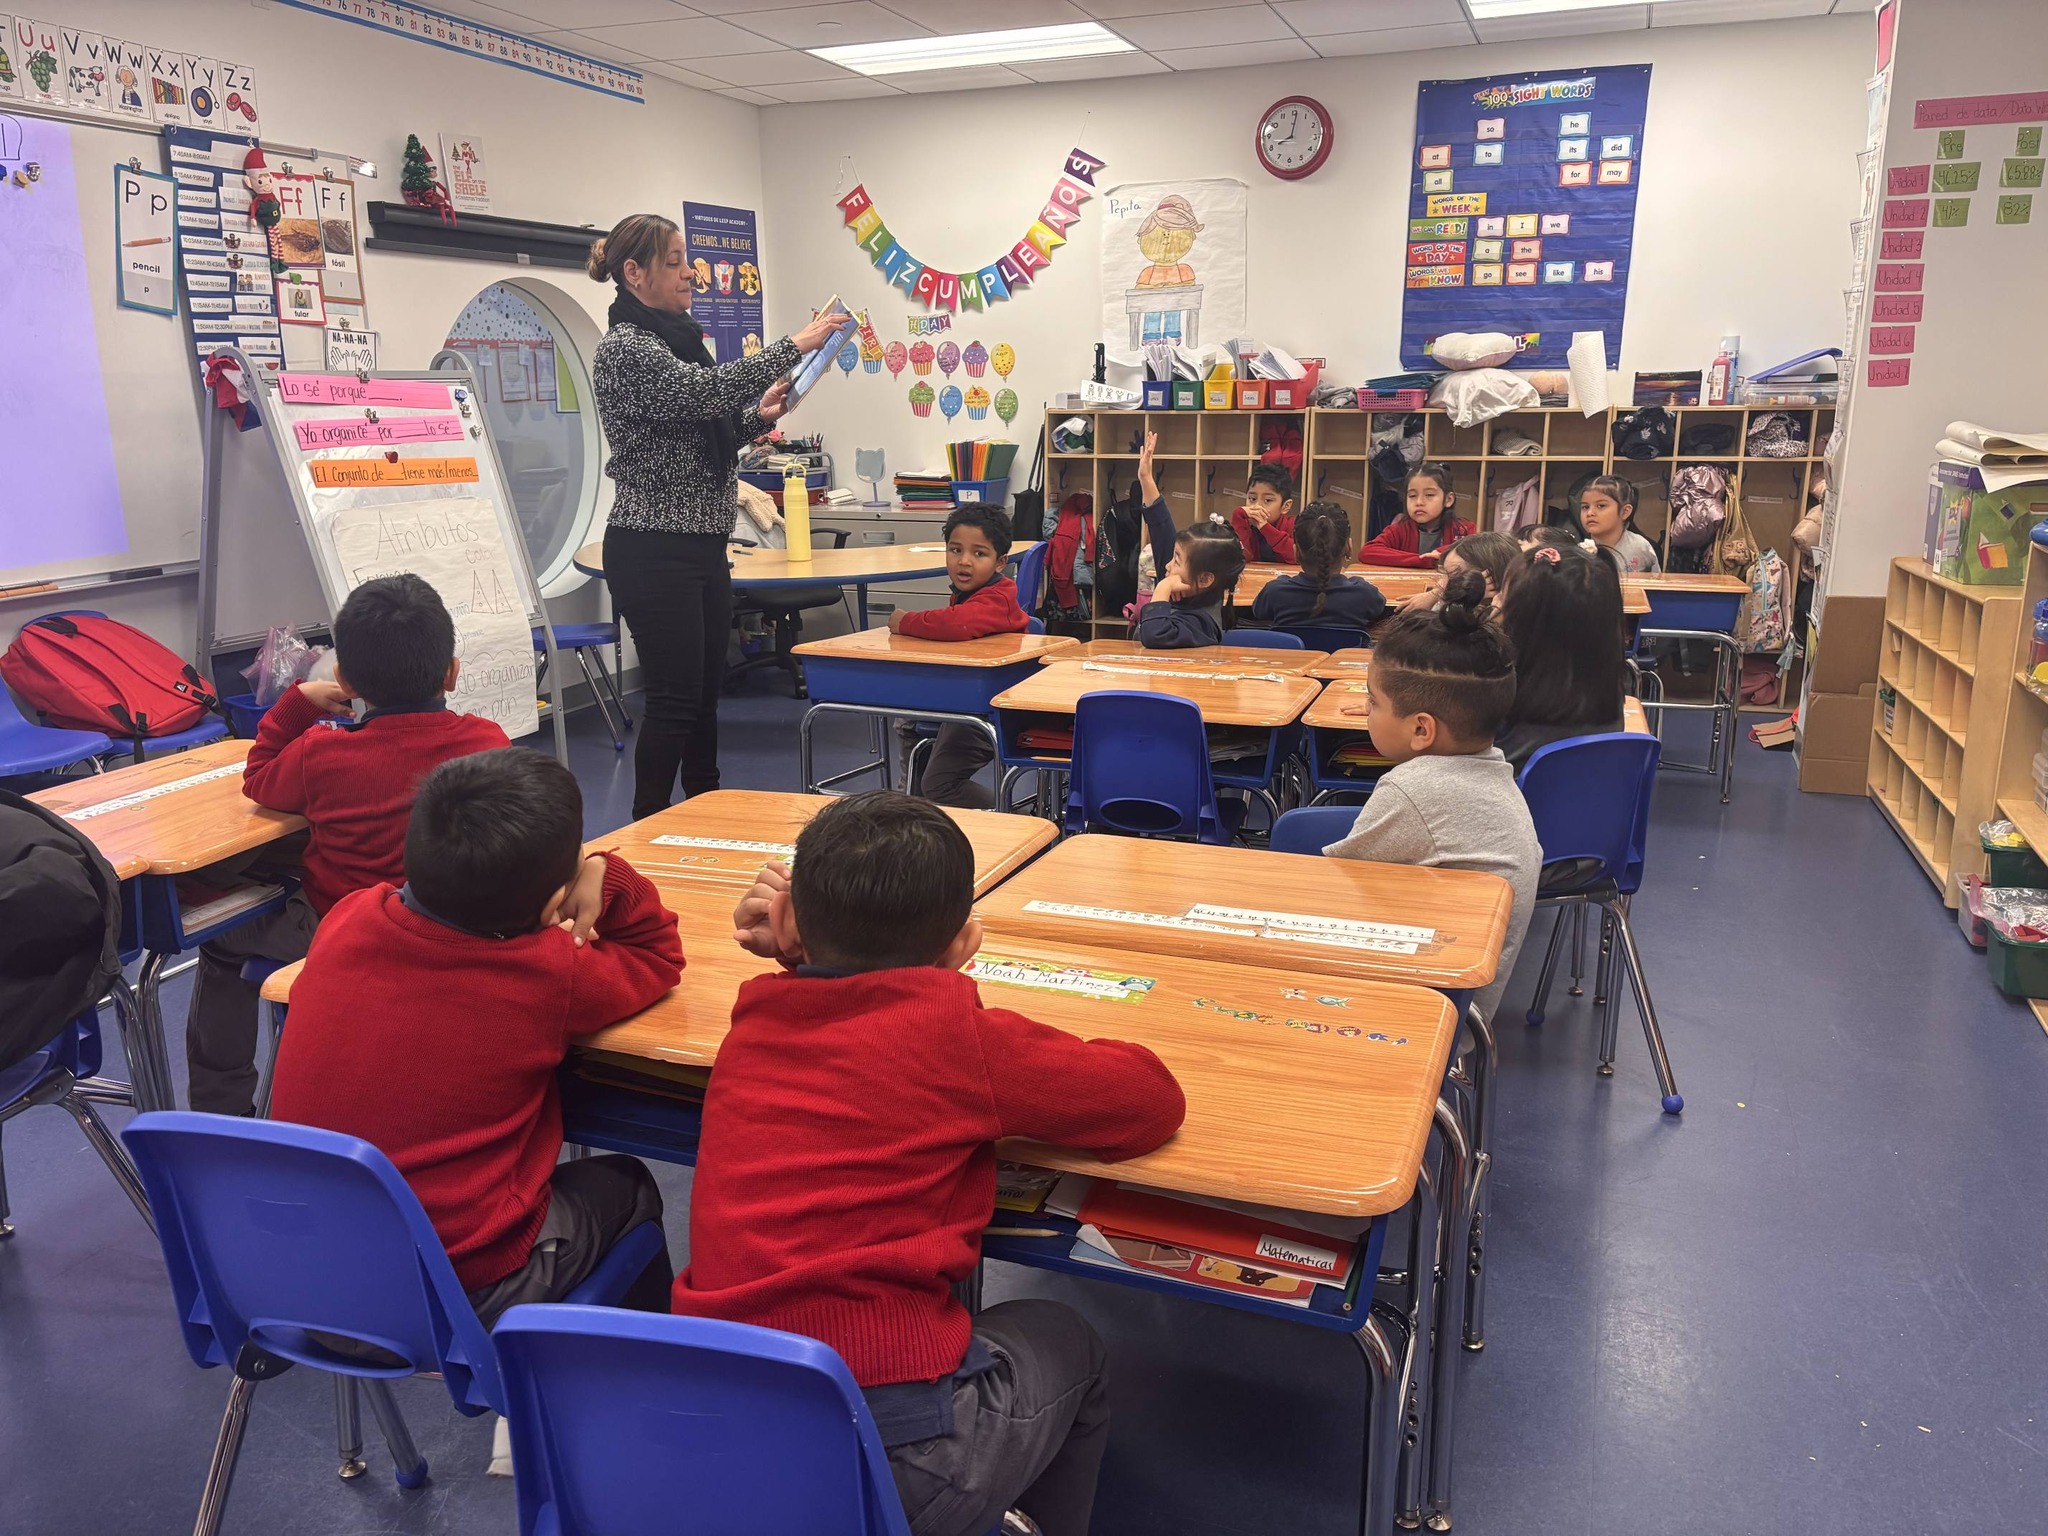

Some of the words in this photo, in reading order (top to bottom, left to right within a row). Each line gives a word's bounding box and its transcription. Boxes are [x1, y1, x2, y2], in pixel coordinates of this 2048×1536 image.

[353, 3, 361, 14] 77
[366, 7, 376, 18] 78
[380, 11, 390, 22] 79
[395, 16, 404, 26] 80
[410, 20, 417, 30] 81
[423, 24, 432, 34] 82
[437, 28, 445, 38] 83
[449, 32, 457, 42] 84
[462, 35, 470, 45] 85
[474, 39, 482, 49] 86
[487, 42, 495, 52] 87
[500, 46, 508, 56] 88
[523, 53, 531, 62] 90
[546, 60, 553, 69] 92
[1489, 94, 1508, 104] 100
[1513, 86, 1547, 104] SIGHT
[1550, 84, 1592, 98] WORDS
[1944, 137, 1963, 152] Pre
[2017, 133, 2040, 150] Post
[1432, 153, 1439, 161] at
[1606, 169, 1622, 177] may
[1434, 178, 1442, 186] all
[1889, 174, 1917, 189] Unidad
[455, 183, 486, 196] SHELF
[126, 180, 140, 203] P
[152, 194, 167, 215] p
[1432, 196, 1454, 205] WORDS
[1110, 199, 1141, 218] Pepita
[1442, 204, 1470, 213] WEEK
[1885, 206, 1915, 222] Unidad
[1920, 206, 1926, 220] 2
[2004, 202, 2029, 215] 82%
[1436, 222, 1466, 235] READ!
[731, 238, 751, 250] BELIEVE
[1412, 246, 1433, 254] WORD
[1883, 238, 1913, 253] Unidad
[1916, 239, 1922, 251] 3
[1426, 252, 1448, 263] DAY
[133, 262, 160, 273] pencil
[1410, 268, 1434, 278] WORDS
[1430, 275, 1461, 285] KNOW
[1879, 270, 1911, 285] Unidad
[1916, 270, 1922, 284] 4
[1875, 301, 1910, 316] Unidad
[1914, 302, 1920, 315] 5
[332, 332, 368, 345] NA-NA-NA
[1870, 333, 1900, 348] Unidad
[1904, 333, 1910, 346] 6
[1868, 366, 1900, 381] Unidad
[281, 377, 299, 396] Lo
[330, 385, 366, 403] porque
[300, 423, 317, 443] Yo
[378, 426, 393, 441] por
[425, 420, 436, 435] lo
[314, 466, 326, 483] El
[372, 463, 384, 480] de
[401, 462, 425, 480] tiene
[966, 491, 972, 499] P
[376, 511, 479, 560] Atributos
[480, 664, 535, 696] organizar
[978, 962, 1025, 981] Noah
[1034, 972, 1116, 992] Martinez
[1260, 1242, 1332, 1270] Matematicas
